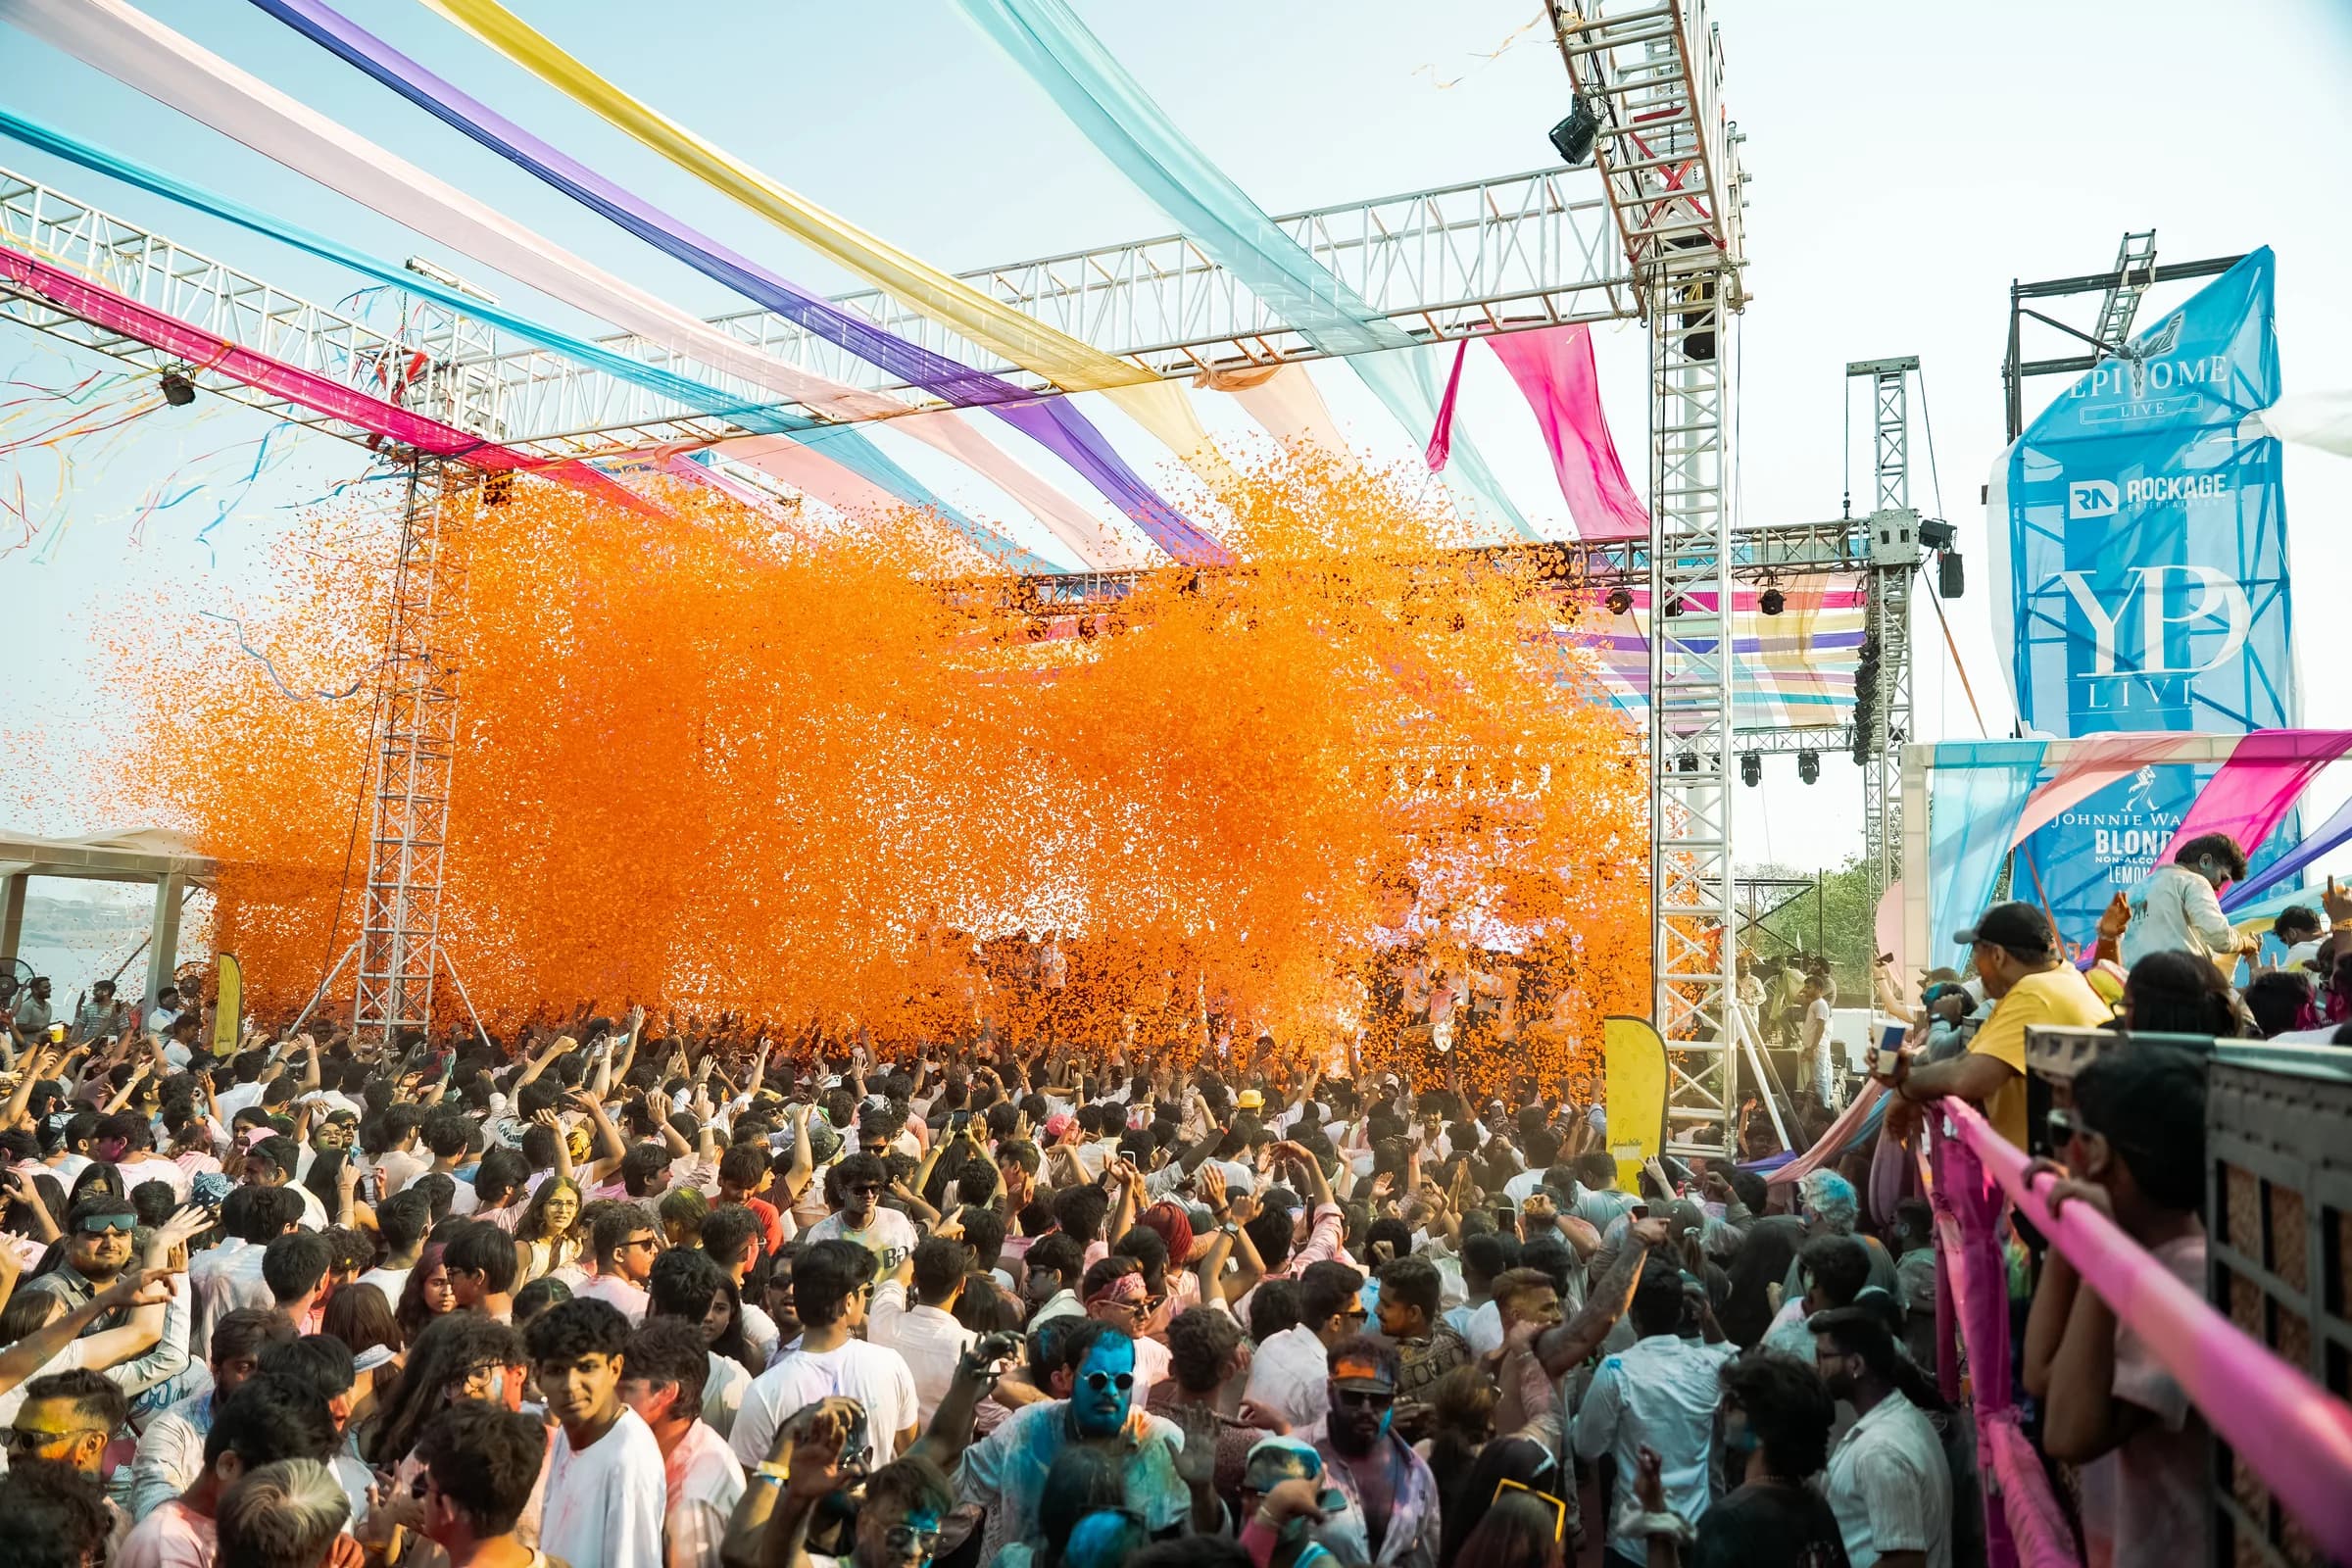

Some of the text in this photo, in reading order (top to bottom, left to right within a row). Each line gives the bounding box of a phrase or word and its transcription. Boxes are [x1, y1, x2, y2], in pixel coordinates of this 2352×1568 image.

[2121, 403, 2165, 416] LIVE
[2127, 474, 2227, 503] ROCKAGE
[2127, 499, 2227, 512] ENTERTAI
[2088, 678, 2203, 708] LIVE
[2051, 813, 2142, 828] JOHNNIE
[2095, 829, 2175, 855] BLOND
[2095, 856, 2158, 864] NON-ALCO
[2109, 866, 2151, 884] LEMON
